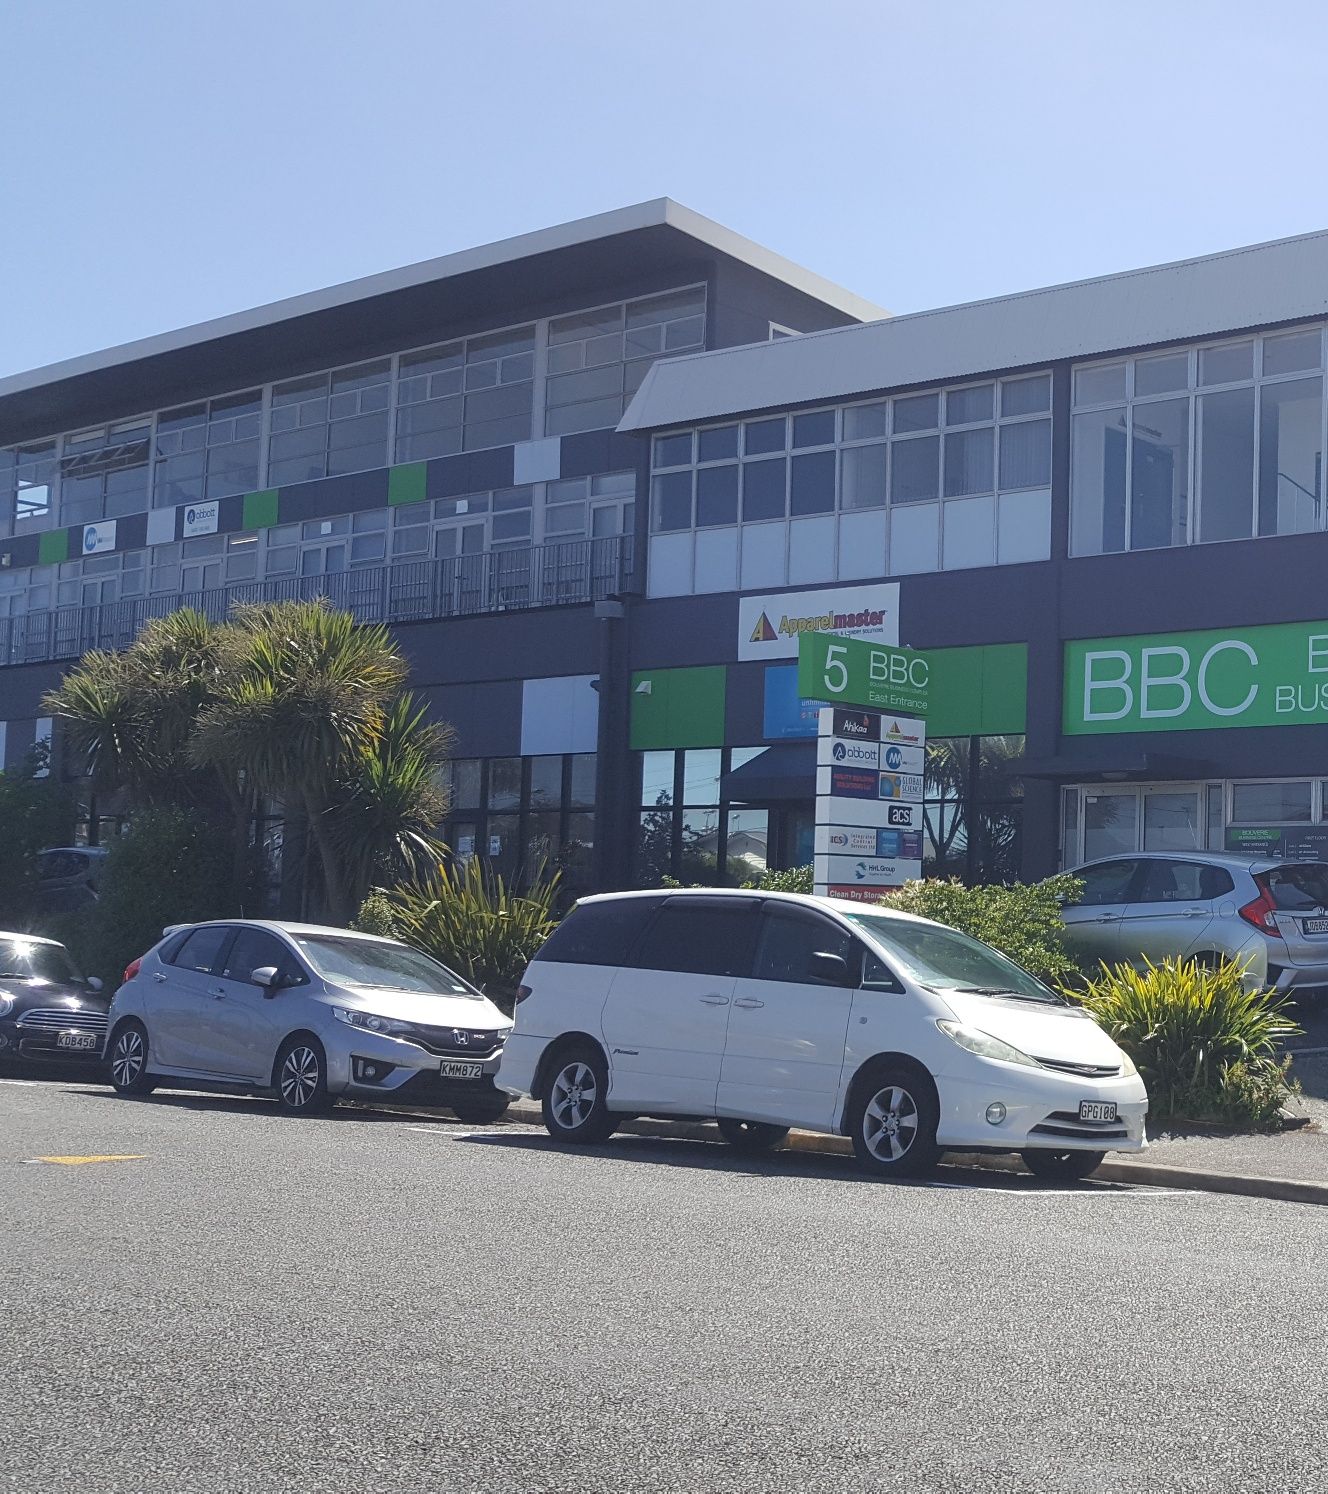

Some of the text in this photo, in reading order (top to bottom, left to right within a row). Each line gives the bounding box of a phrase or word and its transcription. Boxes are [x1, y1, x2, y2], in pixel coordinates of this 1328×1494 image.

[778, 608, 887, 638] Apparelmaster
[824, 644, 848, 693] 5
[869, 650, 929, 688] BBC
[1083, 639, 1259, 722] BBC
[868, 691, 928, 710] East Entrance
[847, 746, 878, 760] abbott
[880, 865, 896, 873] Group
[829, 889, 849, 898] Clean
[851, 890, 863, 900] Dry
[58, 1036, 95, 1047] KDB458
[441, 1063, 481, 1077] KMM872
[1081, 1104, 1115, 1120] GPG108
